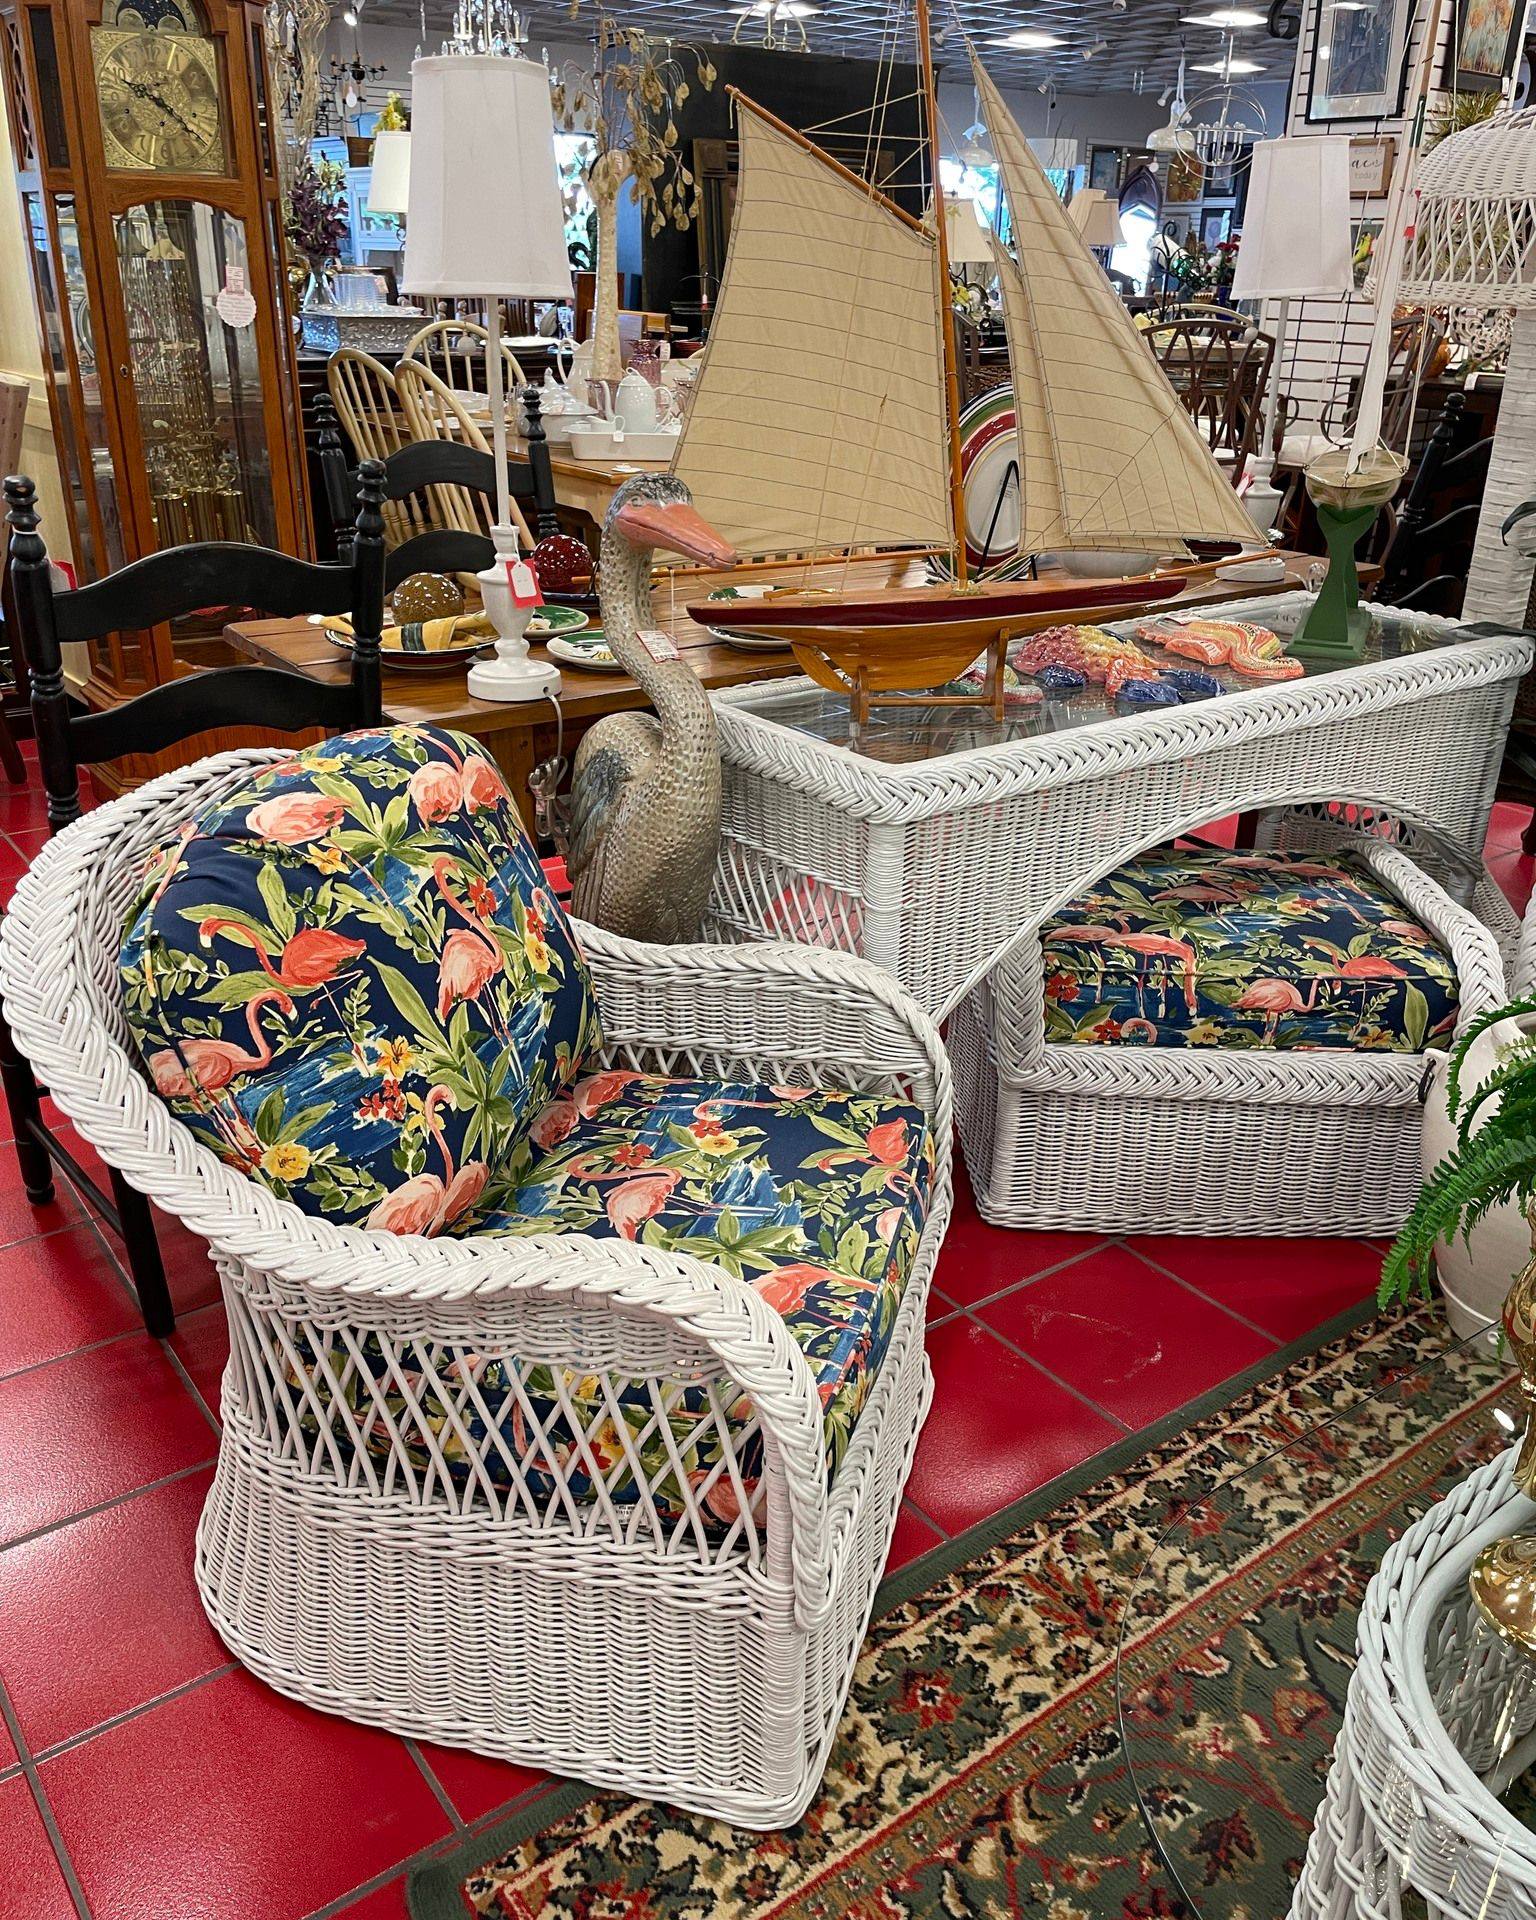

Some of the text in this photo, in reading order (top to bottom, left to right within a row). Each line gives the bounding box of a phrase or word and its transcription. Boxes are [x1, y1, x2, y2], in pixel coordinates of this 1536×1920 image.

[146, 43, 160, 63] 12
[113, 67, 126, 84] 10
[188, 71, 201, 90] 2
[137, 134, 146, 152] 7
